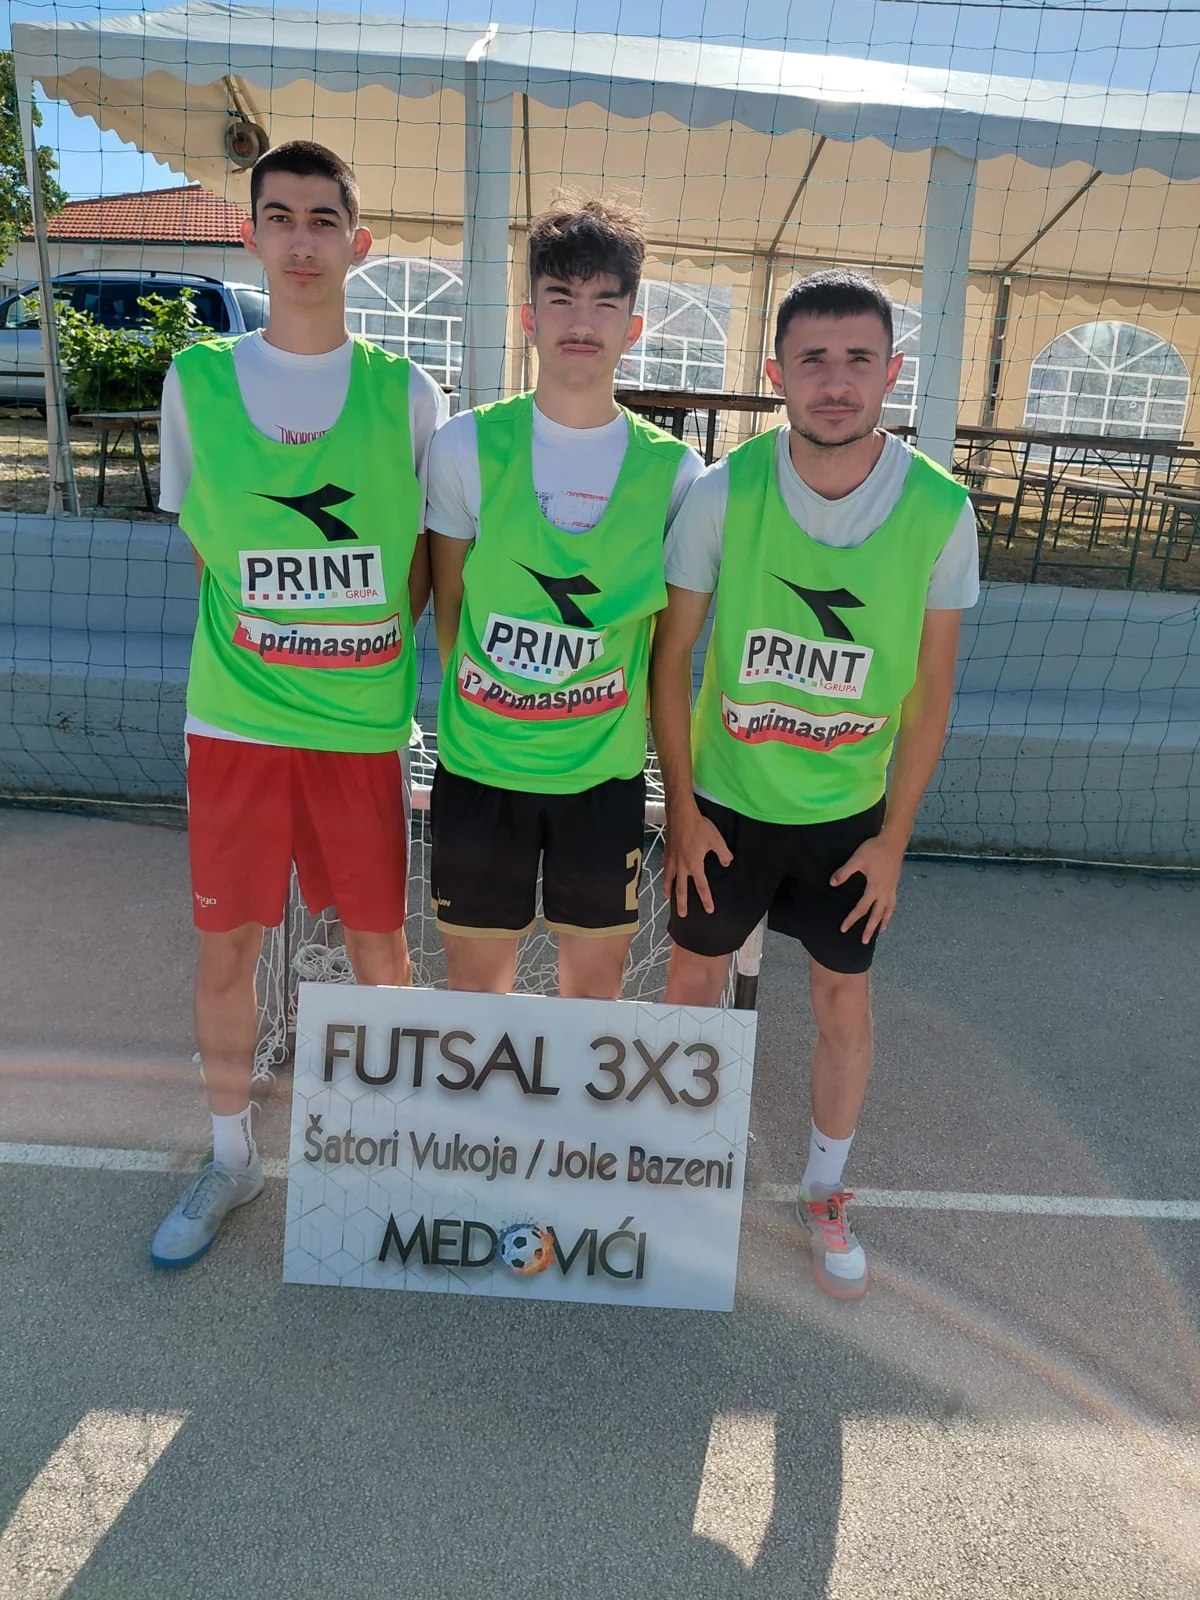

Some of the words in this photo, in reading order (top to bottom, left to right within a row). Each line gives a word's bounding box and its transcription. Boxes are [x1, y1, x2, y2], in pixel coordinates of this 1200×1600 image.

[246, 552, 375, 592] PRINT
[345, 588, 379, 599] GRUPA
[258, 623, 397, 662] primasport
[486, 620, 603, 670] PRINT
[747, 635, 866, 684] PRINT
[824, 682, 858, 693] GRUPA
[745, 708, 876, 748] primasport
[322, 1023, 561, 1097] FUTSAL
[584, 1035, 721, 1108] 3X3
[303, 1112, 399, 1166] Šatori
[409, 1129, 519, 1182] Vukoja
[547, 1139, 617, 1181] Jole
[627, 1144, 735, 1190] Bazeni
